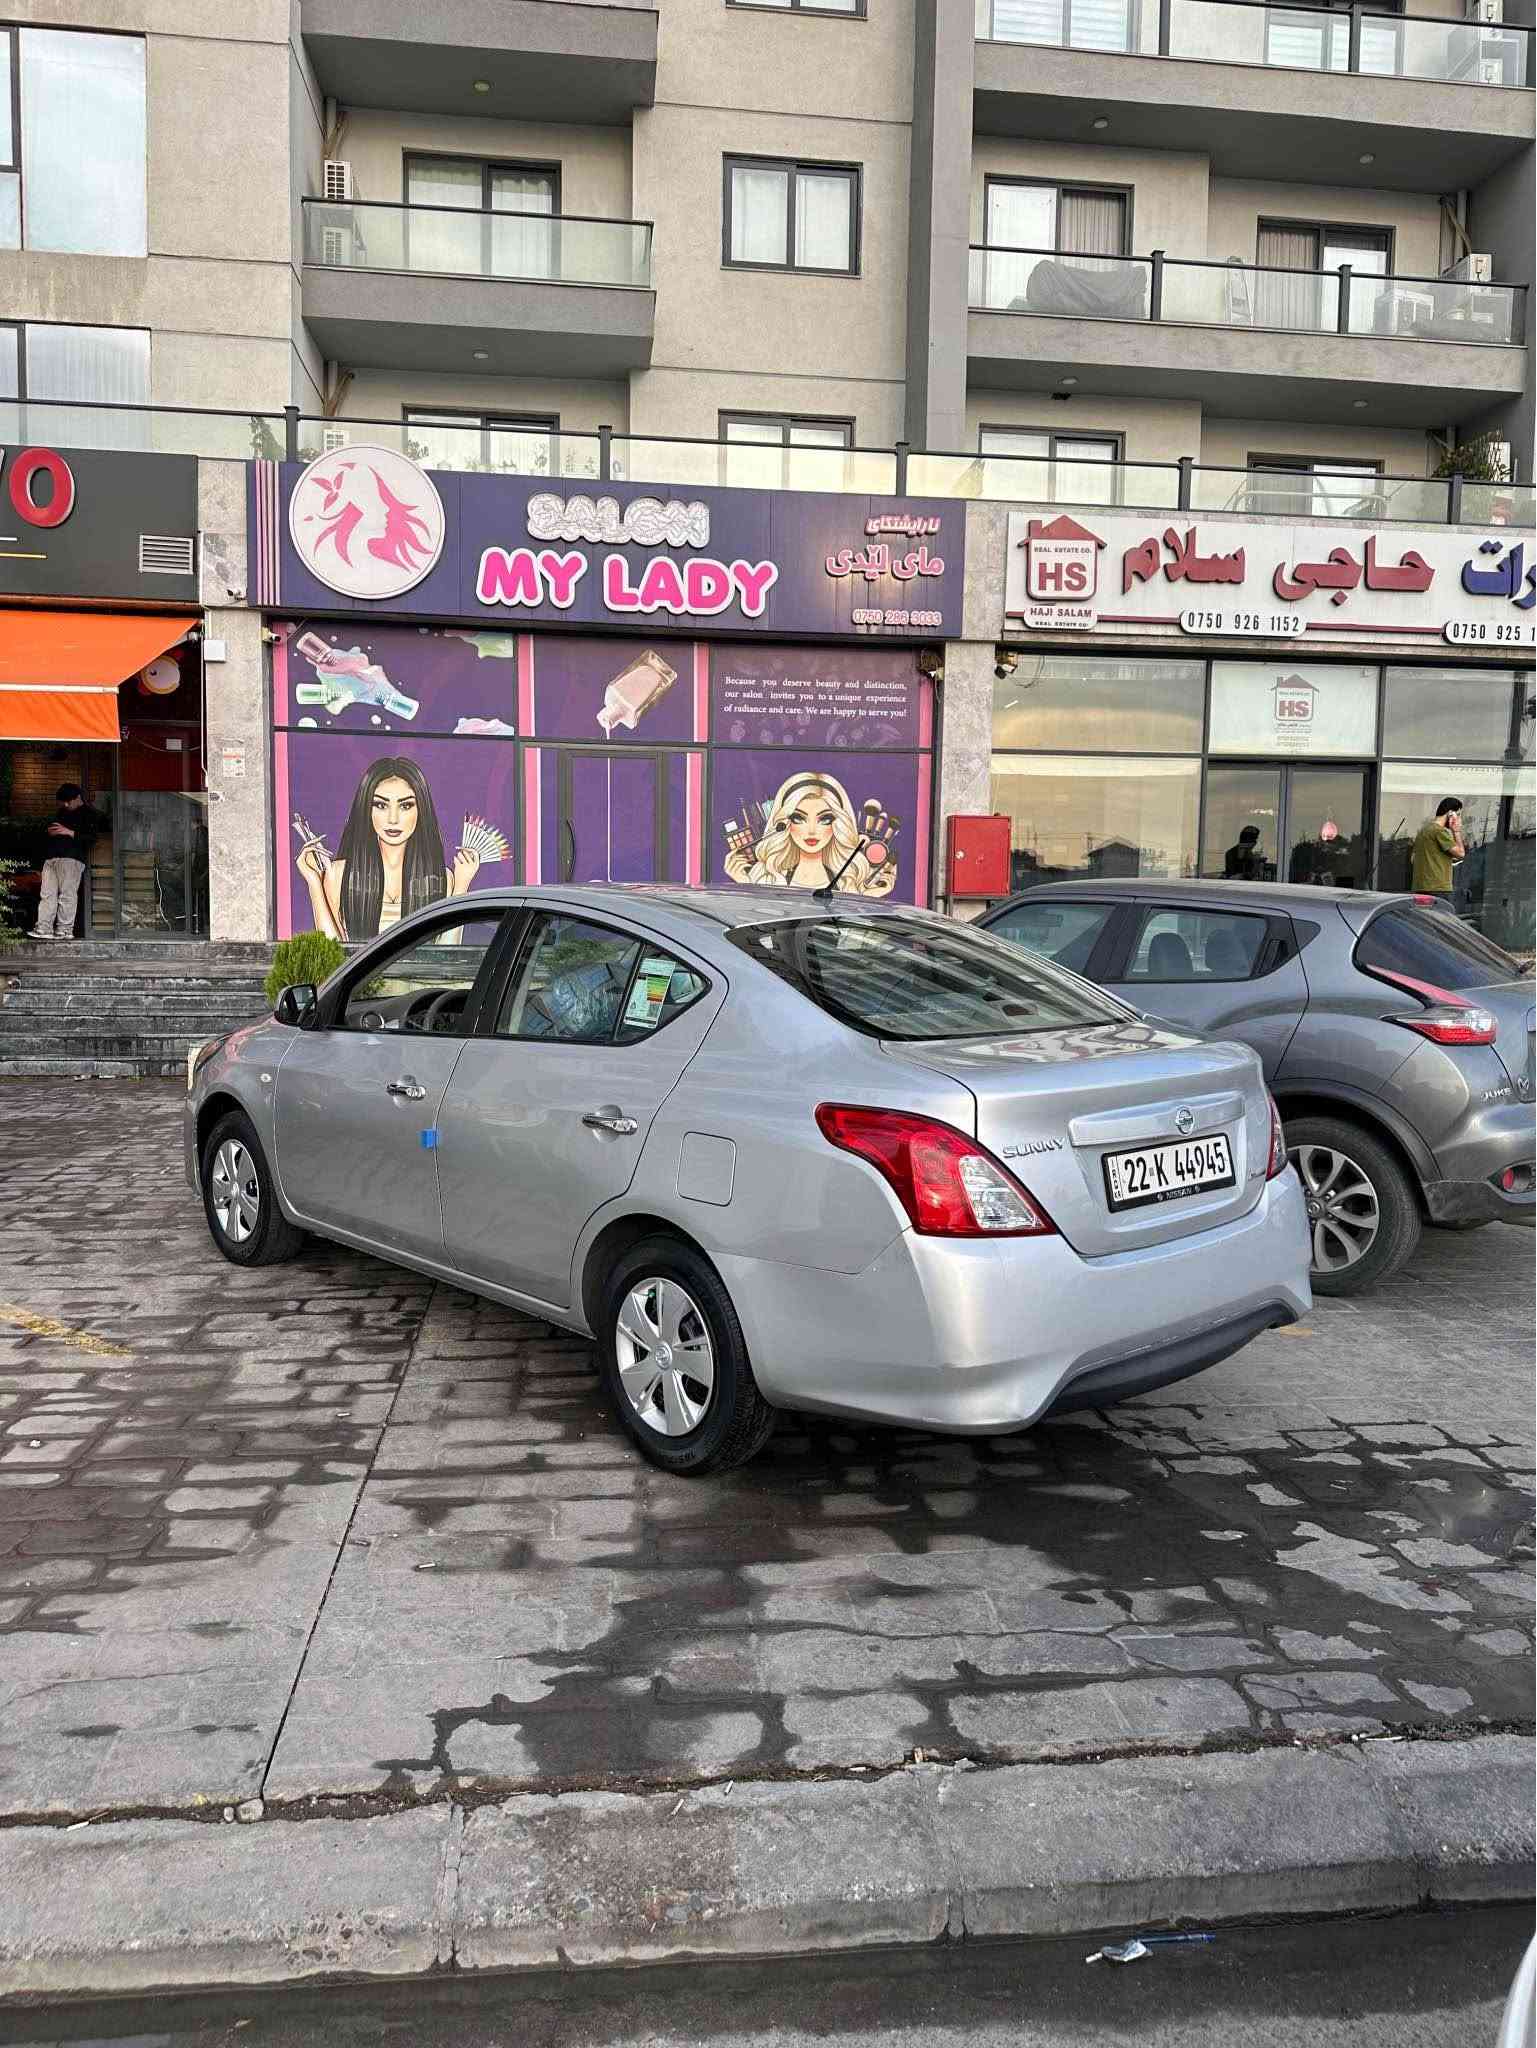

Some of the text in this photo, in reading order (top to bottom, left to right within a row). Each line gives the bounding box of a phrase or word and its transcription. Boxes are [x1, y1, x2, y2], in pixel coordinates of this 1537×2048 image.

[0, 447, 76, 529] O
[527, 493, 710, 549] SALON
[1122, 527, 1246, 596] سلام
[476, 547, 778, 618] MY LADY
[1038, 562, 1087, 592] HS
[852, 608, 883, 624] 0750
[1030, 607, 1093, 618] HAJI SALAM
[1187, 612, 1300, 632] 0750 926 1152
[1453, 623, 1486, 639] 0750
[1496, 625, 1521, 641] 925
[725, 676, 907, 690] Because you deserve beauty and distinction,
[742, 690, 763, 699] salon
[770, 691, 796, 700] invites
[799, 694, 814, 703] you
[835, 693, 862, 703] unique
[865, 695, 906, 704] experience
[724, 703, 733, 712] of
[734, 704, 767, 713] radiance
[769, 705, 783, 713] and
[785, 706, 803, 714] care.
[806, 706, 818, 714] We
[833, 706, 857, 718] happy
[858, 708, 867, 716] to
[869, 709, 888, 717] serve
[889, 708, 907, 718] you!
[1278, 700, 1310, 718] HS
[1480, 1088, 1512, 1102] JUKE
[1002, 1137, 1065, 1159] SUNNY
[1124, 1142, 1226, 1194] 22 K 44945
[1166, 1187, 1193, 1200] NISSAN
